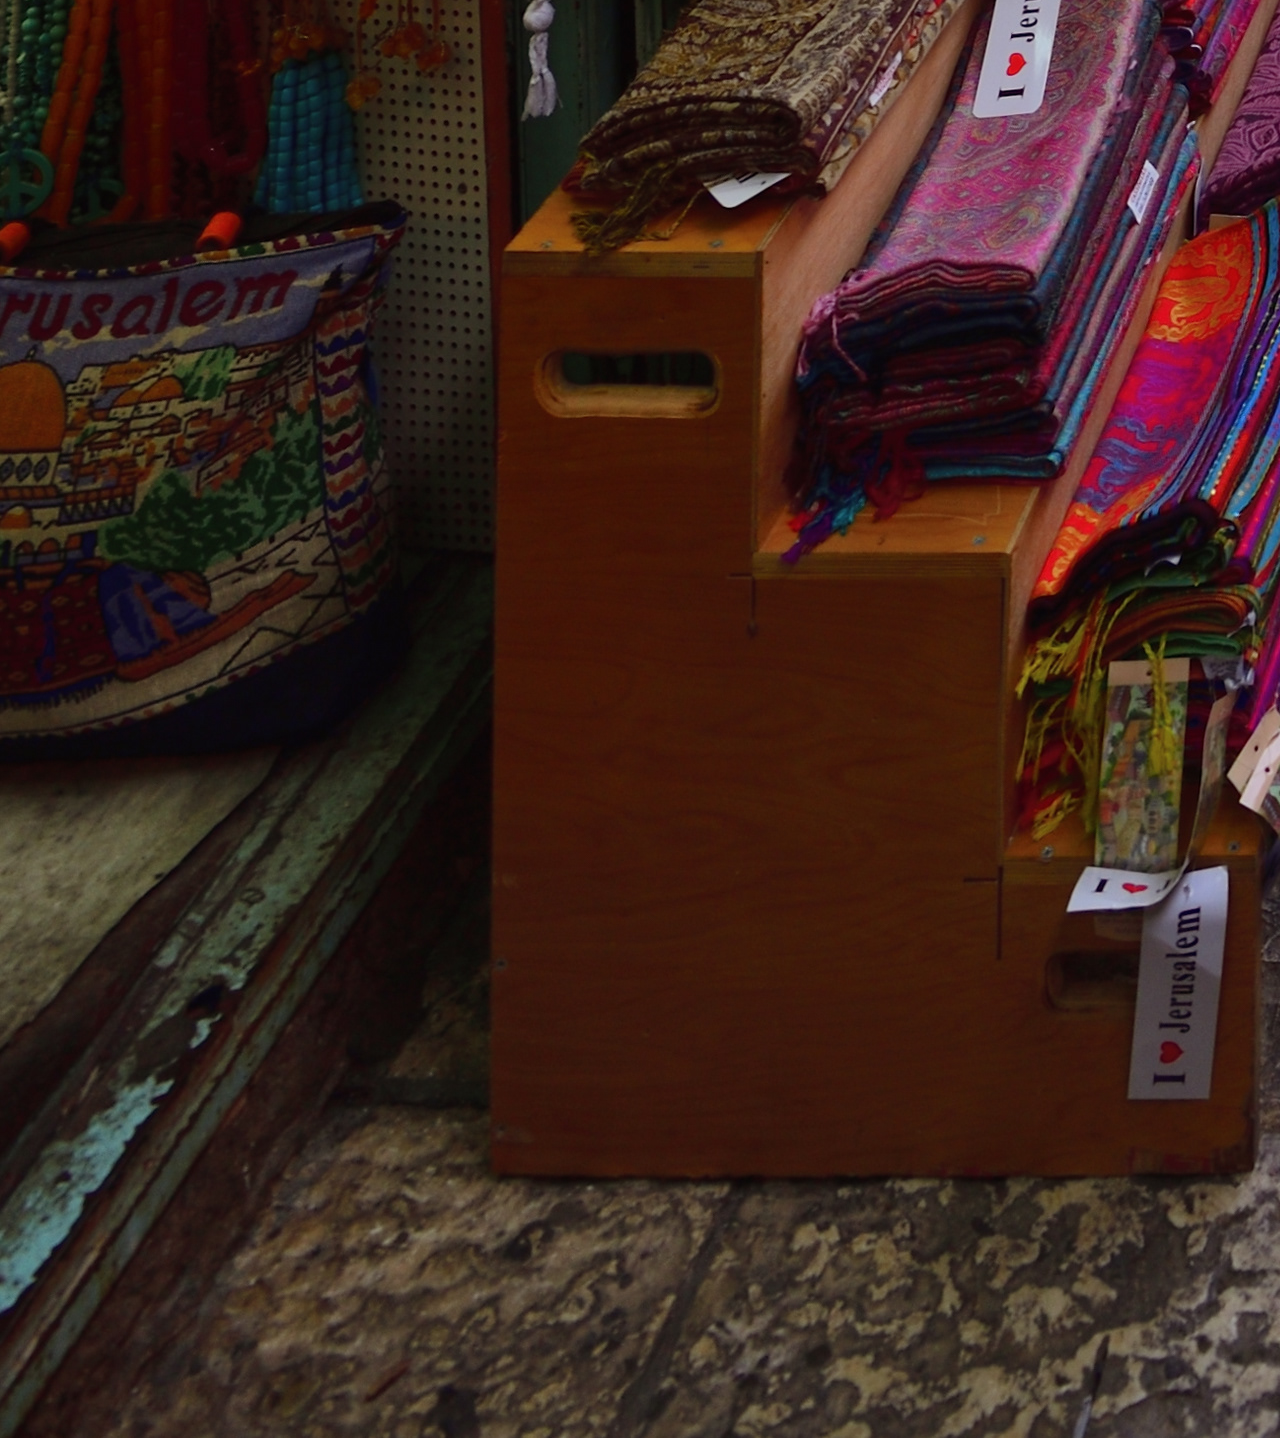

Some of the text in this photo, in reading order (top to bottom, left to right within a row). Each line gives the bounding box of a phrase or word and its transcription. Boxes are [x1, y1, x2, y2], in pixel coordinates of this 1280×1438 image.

[996, 83, 1025, 102] I
[1153, 906, 1201, 1086] I Jerusalem
